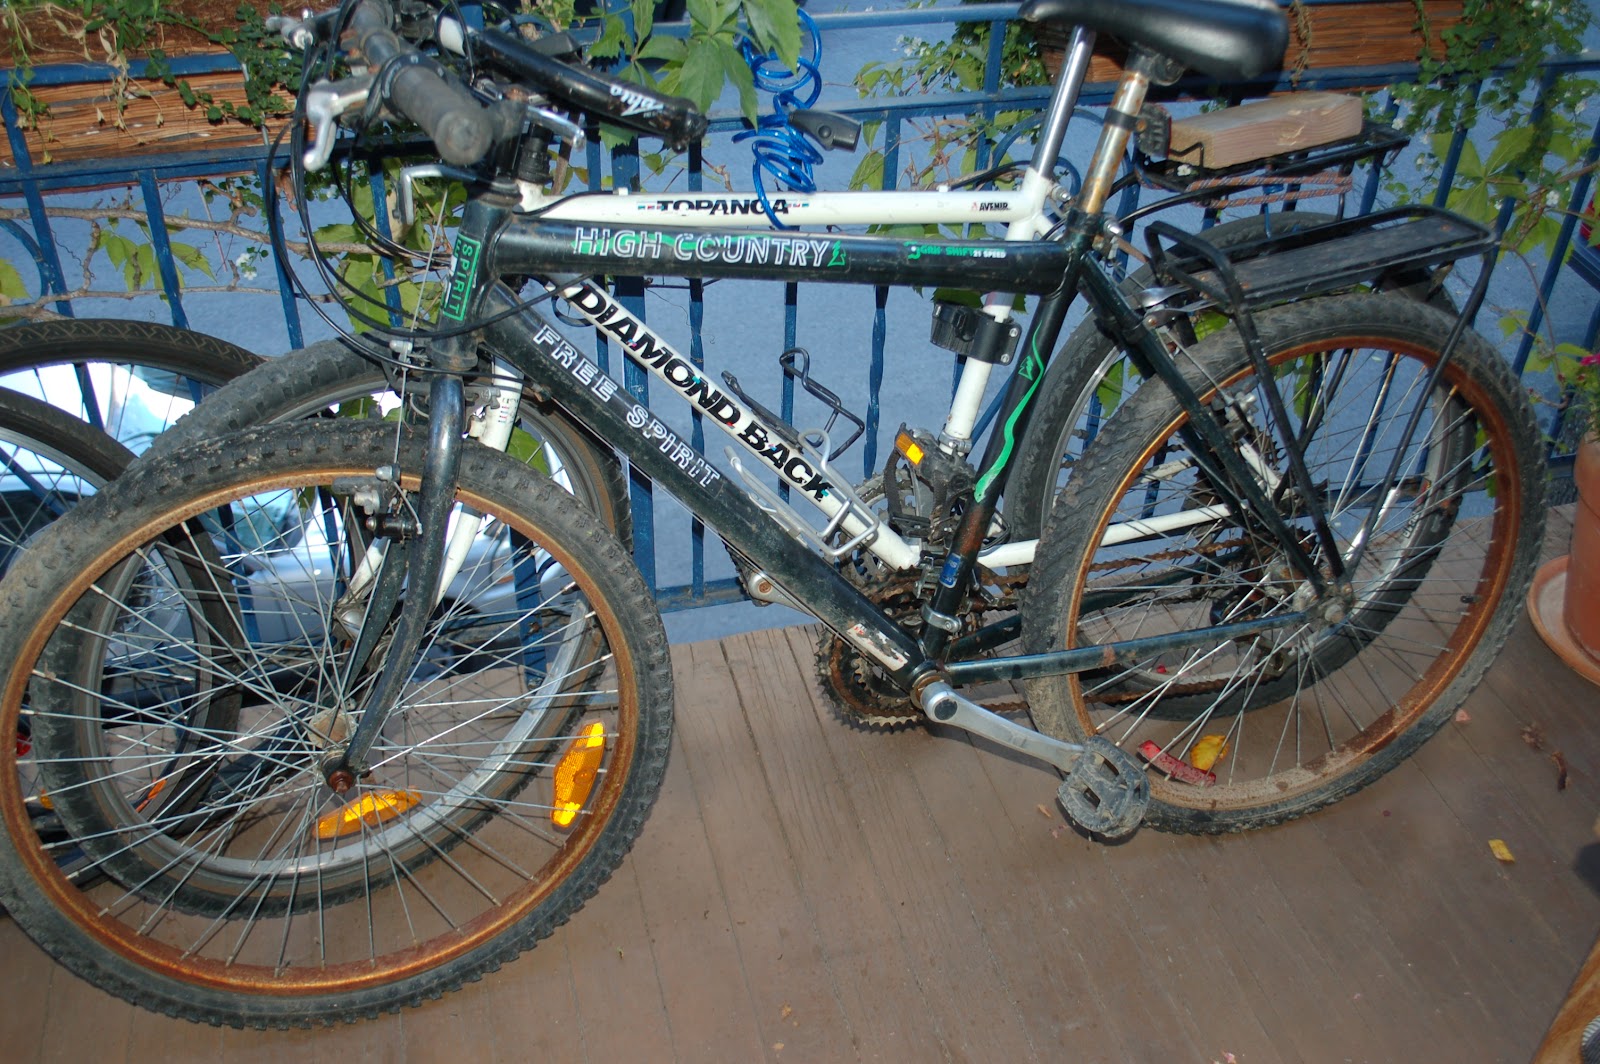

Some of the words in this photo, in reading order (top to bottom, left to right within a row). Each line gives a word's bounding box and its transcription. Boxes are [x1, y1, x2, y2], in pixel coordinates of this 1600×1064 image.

[658, 199, 789, 215] TOPANGA
[574, 226, 662, 259] HIGH
[673, 233, 830, 267] COUNTRY
[946, 246, 975, 256] SHIFT
[983, 250, 1007, 258] SPEED
[449, 243, 473, 315] SPIRIT
[532, 323, 619, 402] FREE
[626, 403, 721, 488] SPIRIT
[570, 284, 741, 430] DIAMOND
[738, 424, 836, 503] BACK
